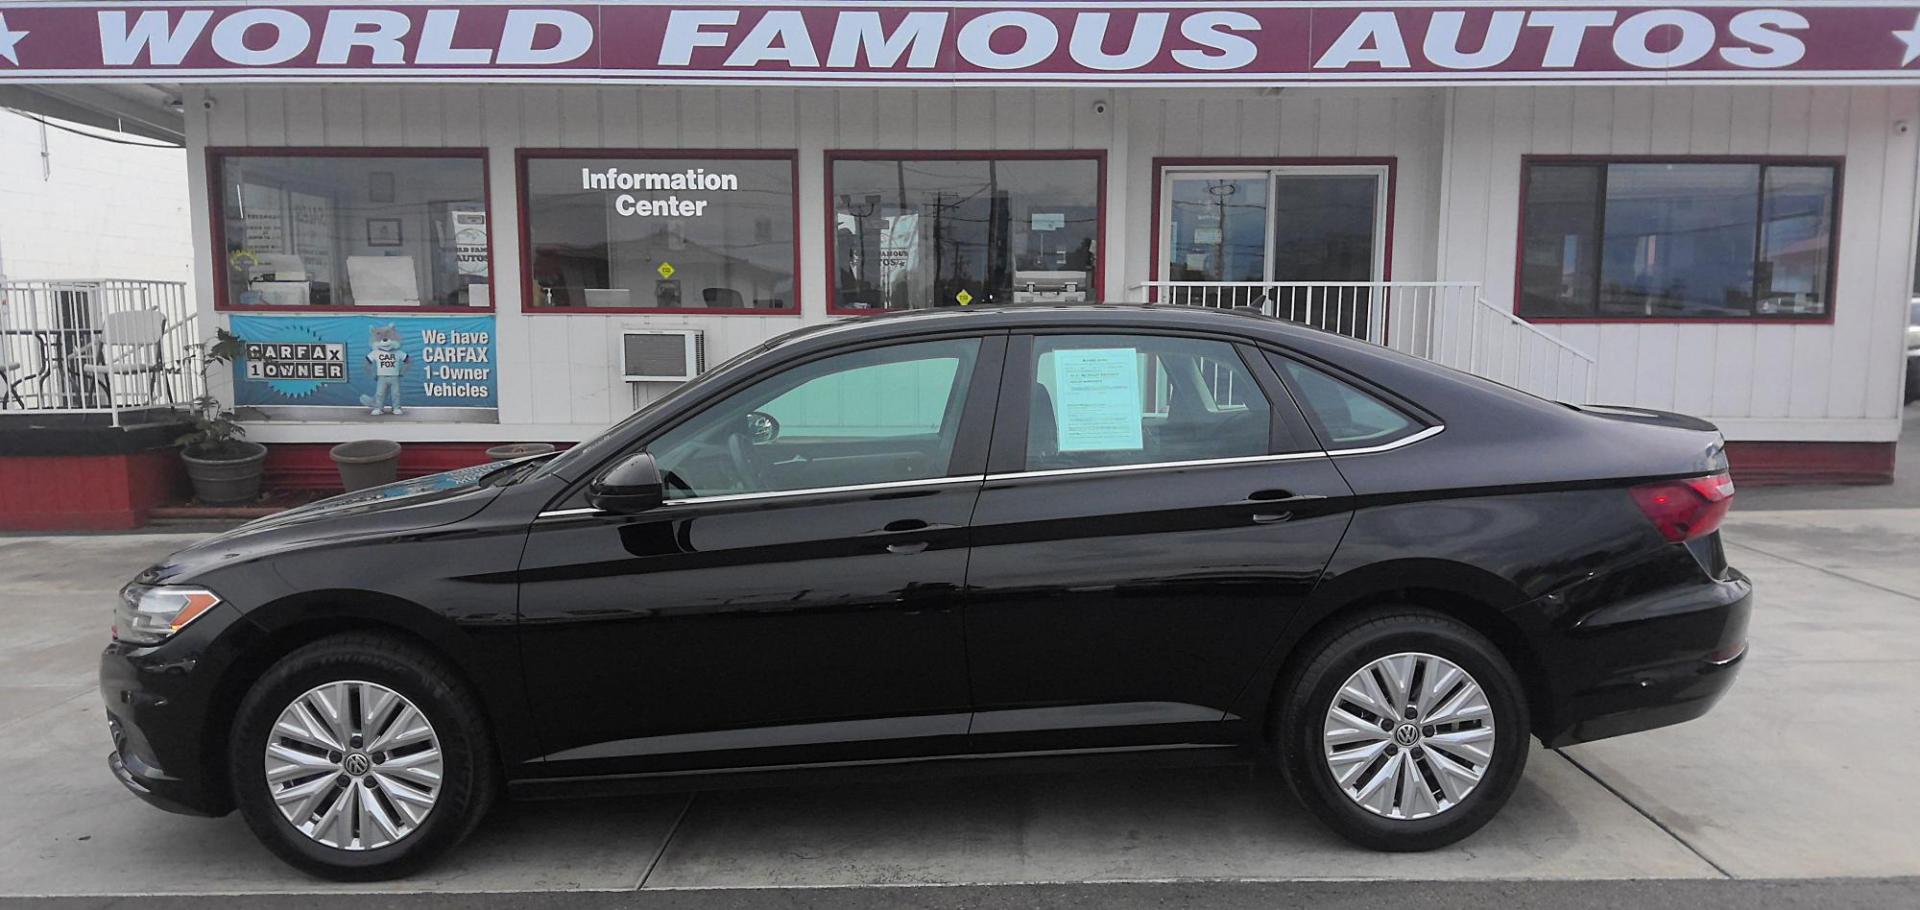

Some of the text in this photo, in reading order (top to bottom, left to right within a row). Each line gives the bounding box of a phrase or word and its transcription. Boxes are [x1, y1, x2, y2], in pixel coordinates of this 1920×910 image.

[97, 8, 1811, 70] WORLD FAMOUS AUTOS
[582, 168, 738, 191] Information
[615, 194, 707, 216] Center
[422, 330, 489, 344] We have
[249, 345, 341, 361] CARFAX
[422, 347, 489, 363] CARFAX
[251, 364, 341, 377] 1 OWNER
[424, 365, 489, 380] 1-Owner
[424, 382, 489, 397] Vehicles
